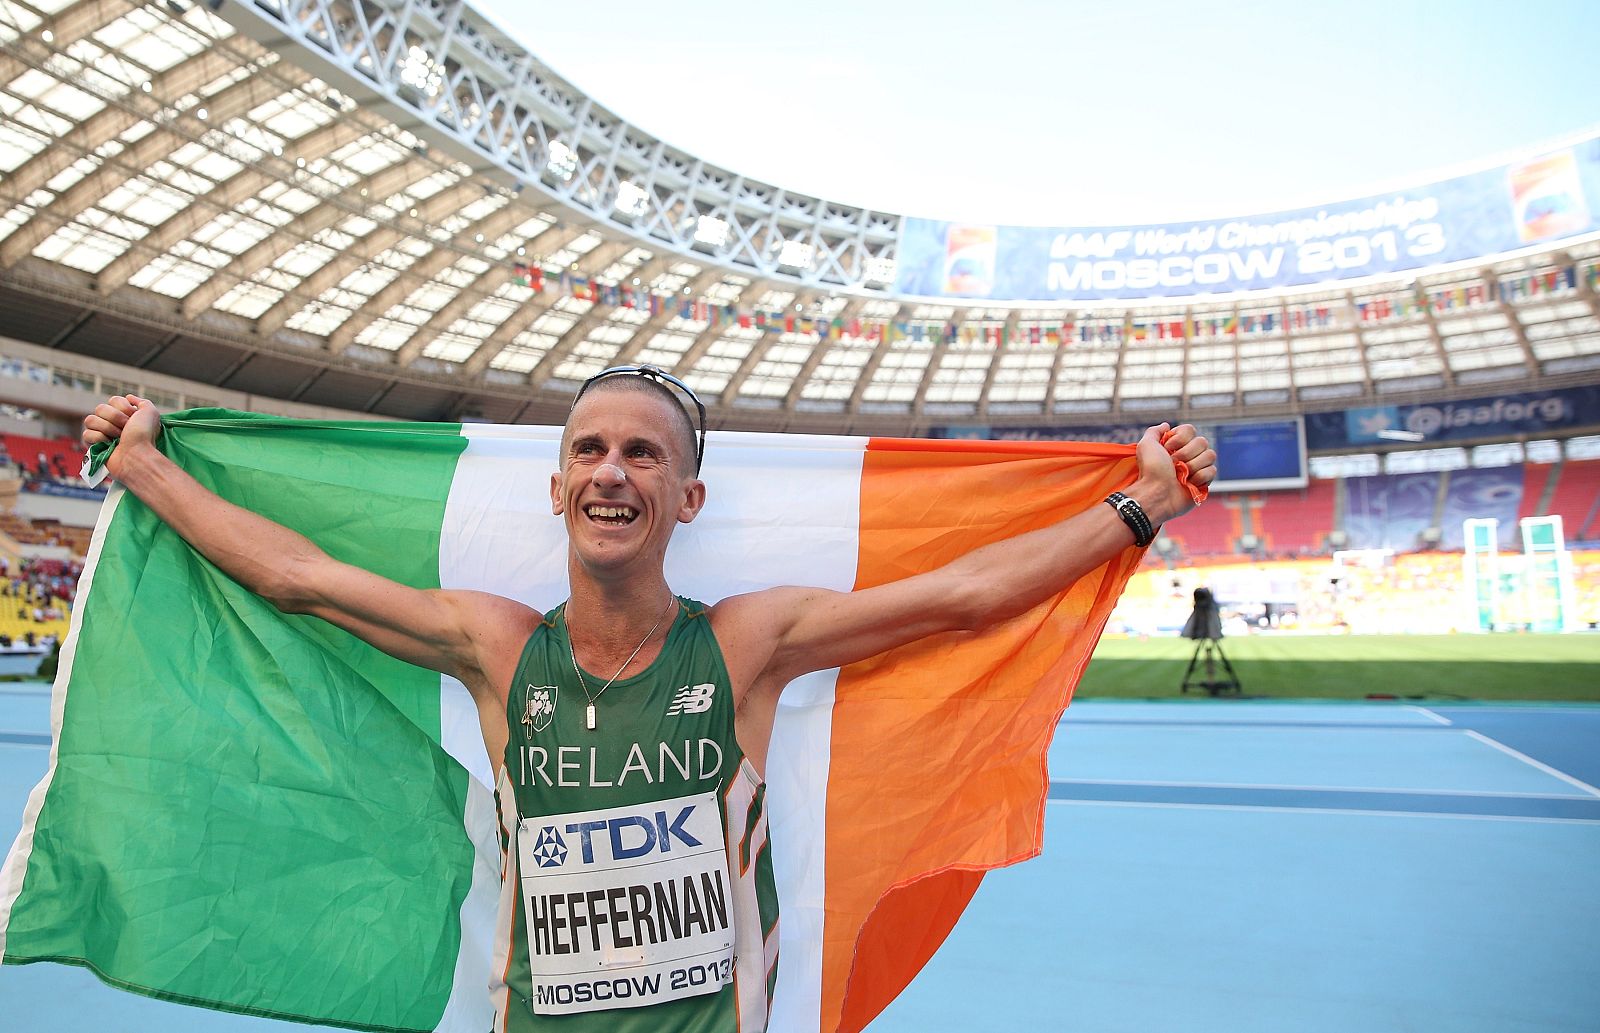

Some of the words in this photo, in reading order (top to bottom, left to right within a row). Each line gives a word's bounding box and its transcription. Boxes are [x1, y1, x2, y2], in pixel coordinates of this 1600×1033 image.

[1046, 247, 1285, 291] MOSCOW
[1297, 222, 1446, 275] 2013
[1050, 230, 1131, 258] IAAF
[1135, 226, 1216, 255] World
[1218, 197, 1439, 248] Championships
[1406, 398, 1565, 434] @iaaforg
[520, 738, 723, 787] IRELAND
[566, 805, 703, 864] TDK
[531, 869, 729, 956] HEFFERNAN
[537, 974, 661, 1006] MOSCOW
[670, 957, 731, 990] 2013
